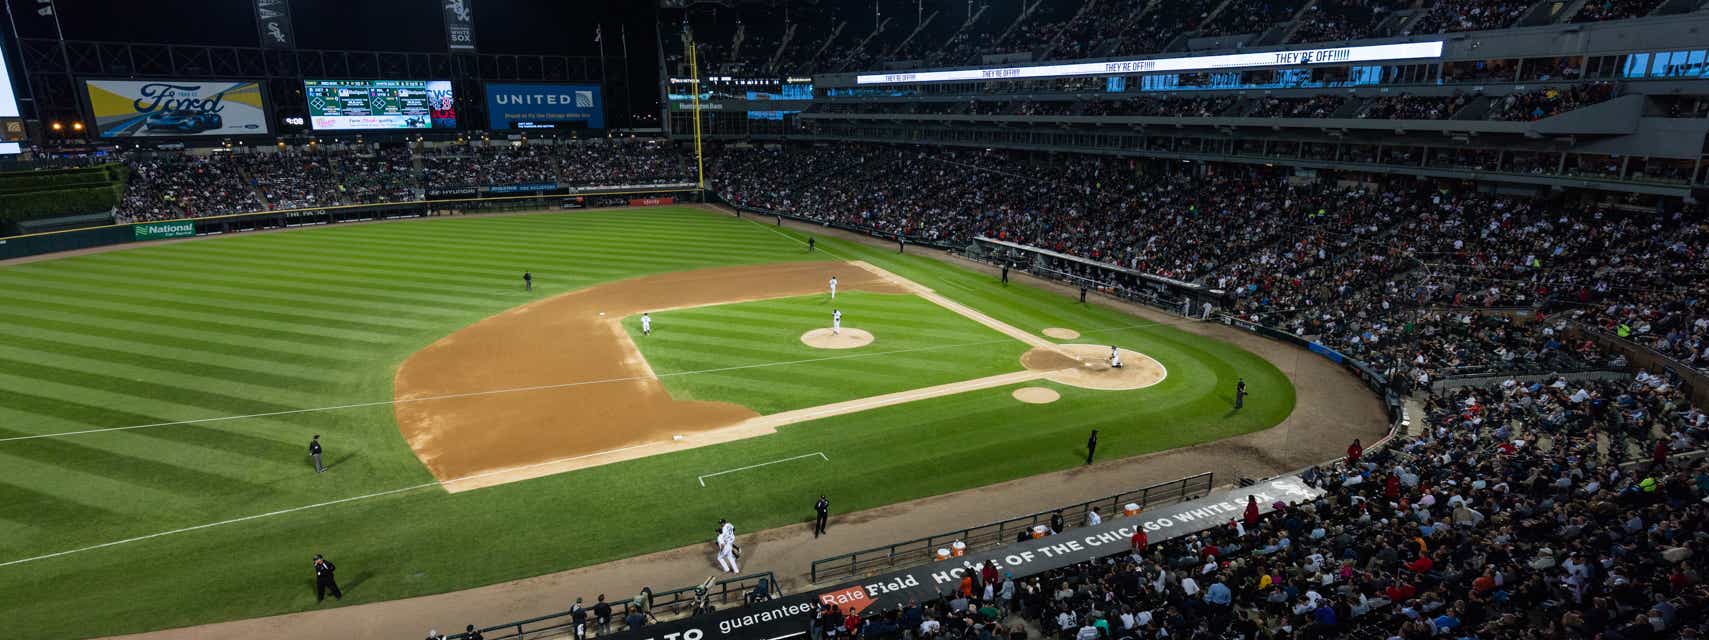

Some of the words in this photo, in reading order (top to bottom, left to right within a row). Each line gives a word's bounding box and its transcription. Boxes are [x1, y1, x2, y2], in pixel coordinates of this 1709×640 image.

[1105, 62, 1132, 72] THEY'RE
[134, 83, 225, 114] Ford
[495, 94, 571, 105] UNITED
[149, 223, 193, 234] National
[1004, 549, 1035, 567] OF
[1038, 540, 1084, 558] THE
[1174, 501, 1235, 521] WHITE
[822, 590, 864, 606] Rate
[865, 574, 920, 597] Field
